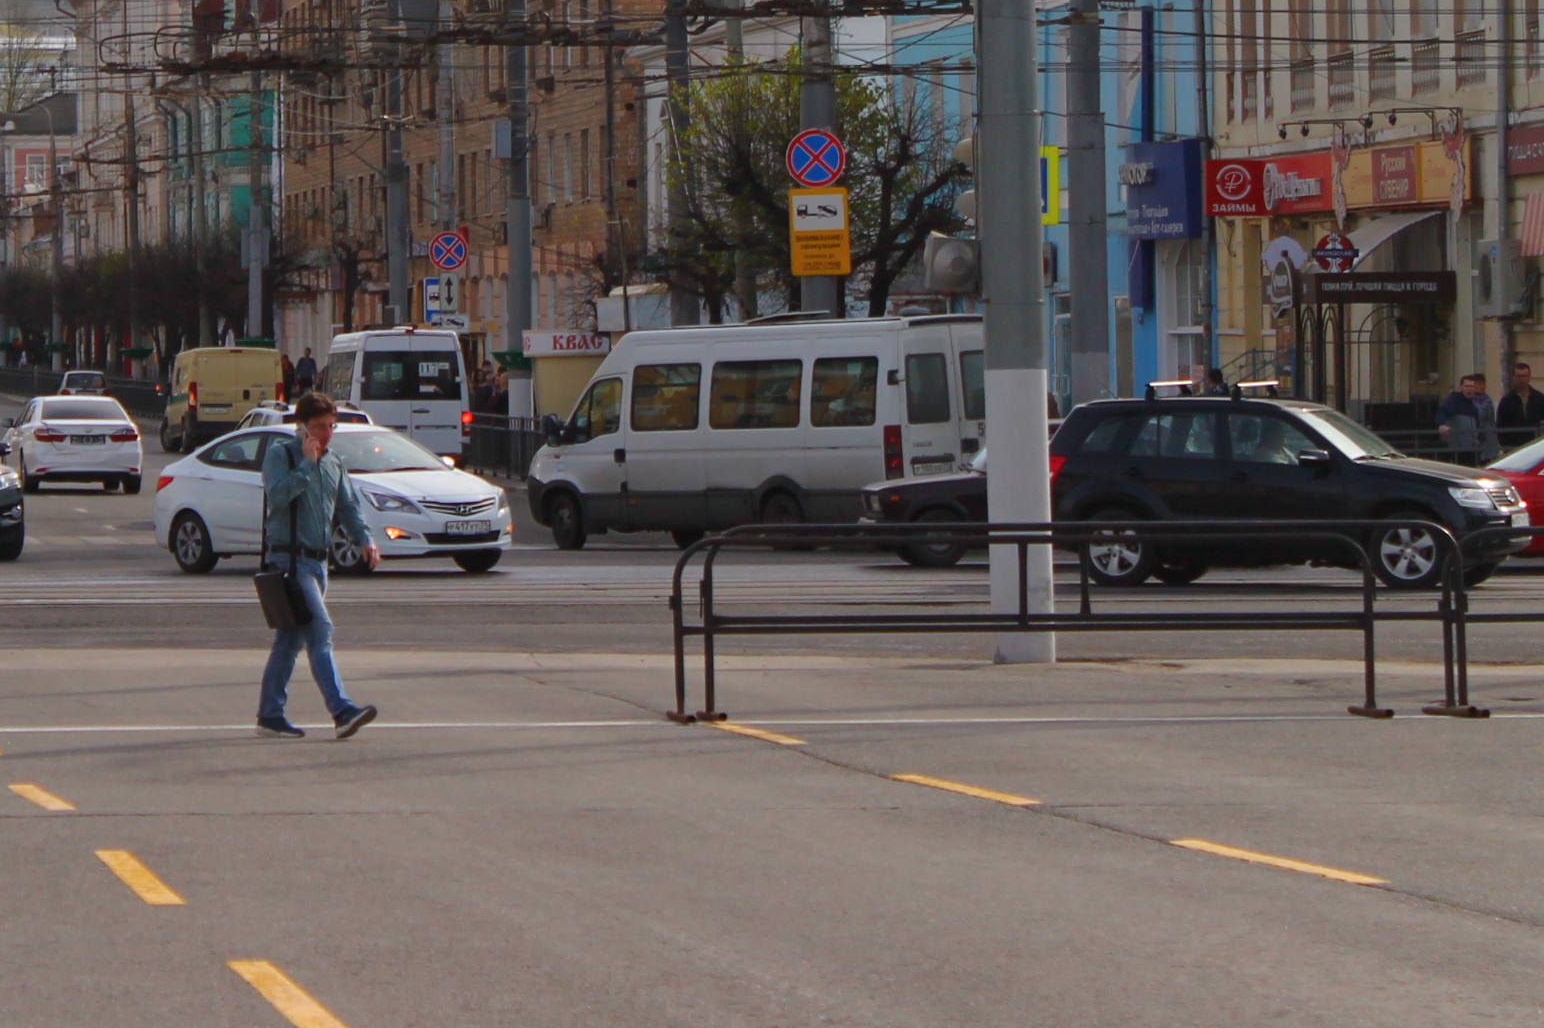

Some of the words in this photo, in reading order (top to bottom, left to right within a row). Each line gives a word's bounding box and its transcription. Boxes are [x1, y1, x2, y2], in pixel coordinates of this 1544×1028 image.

[1379, 178, 1409, 200] СУВЕНИР
[1212, 203, 1256, 213] ЗАЙМЫ
[1412, 282, 1438, 292] ГОРОДЕ
[552, 334, 603, 350] КВАС
